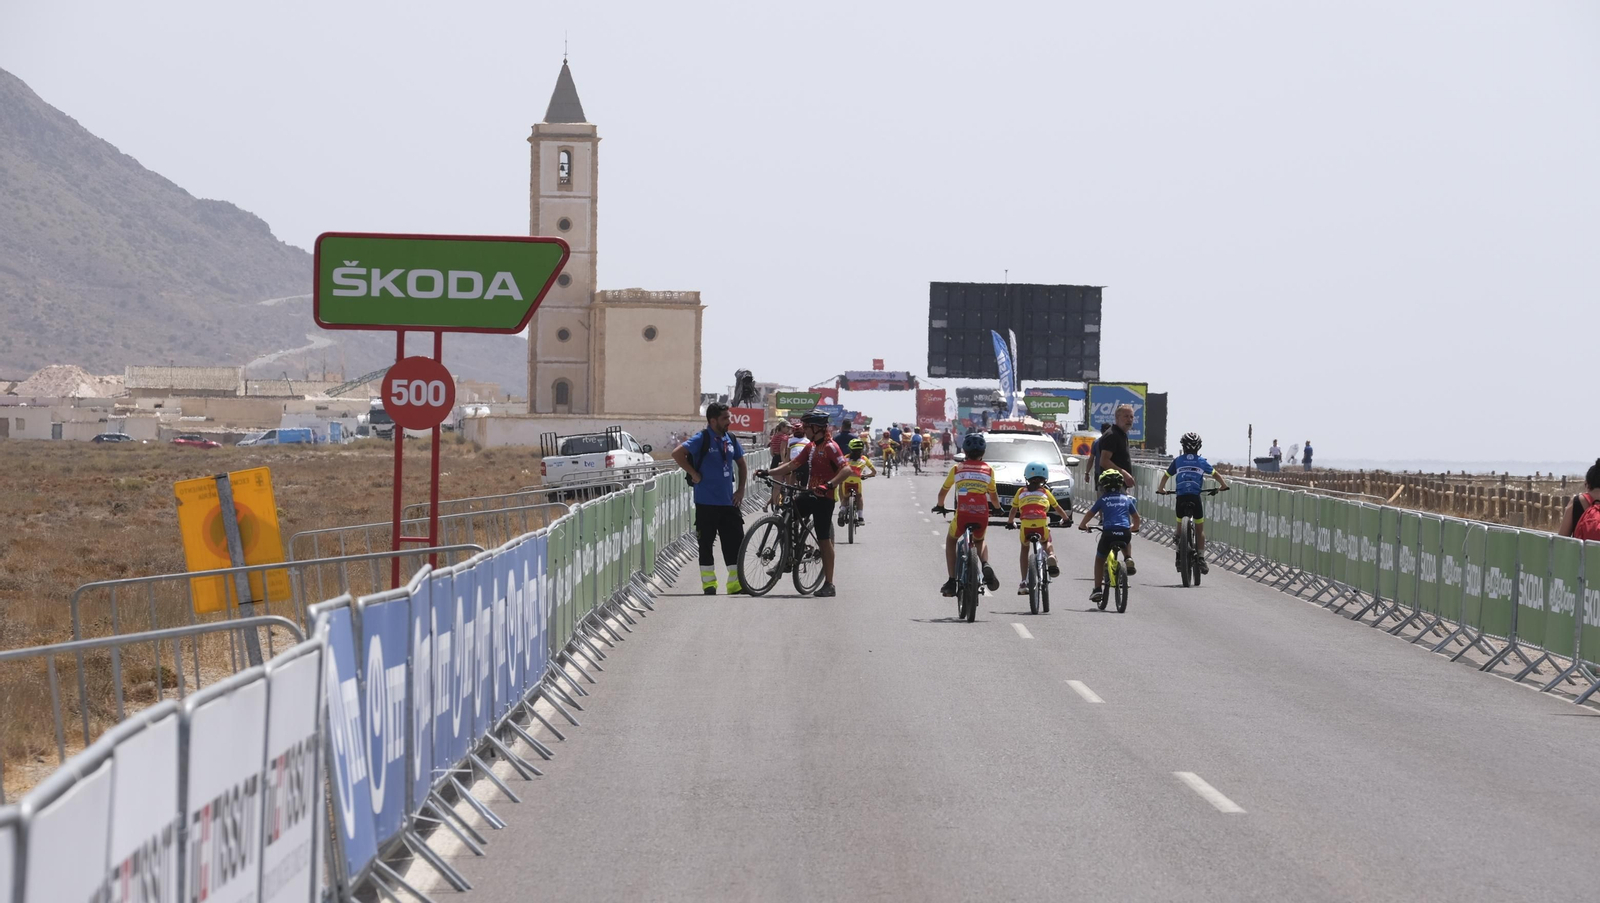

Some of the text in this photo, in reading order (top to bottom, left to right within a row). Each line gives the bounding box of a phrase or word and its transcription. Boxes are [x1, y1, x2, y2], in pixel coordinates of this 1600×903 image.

[332, 260, 523, 301] ŠKODA
[391, 379, 446, 407] 500
[779, 397, 814, 405] ŠKODA
[1030, 401, 1065, 409] ŠKODA
[1091, 399, 1143, 415] valir
[1518, 563, 1545, 611] ŠKODA
[1583, 579, 1600, 628] ŠKO
[211, 772, 258, 893] TISSOT
